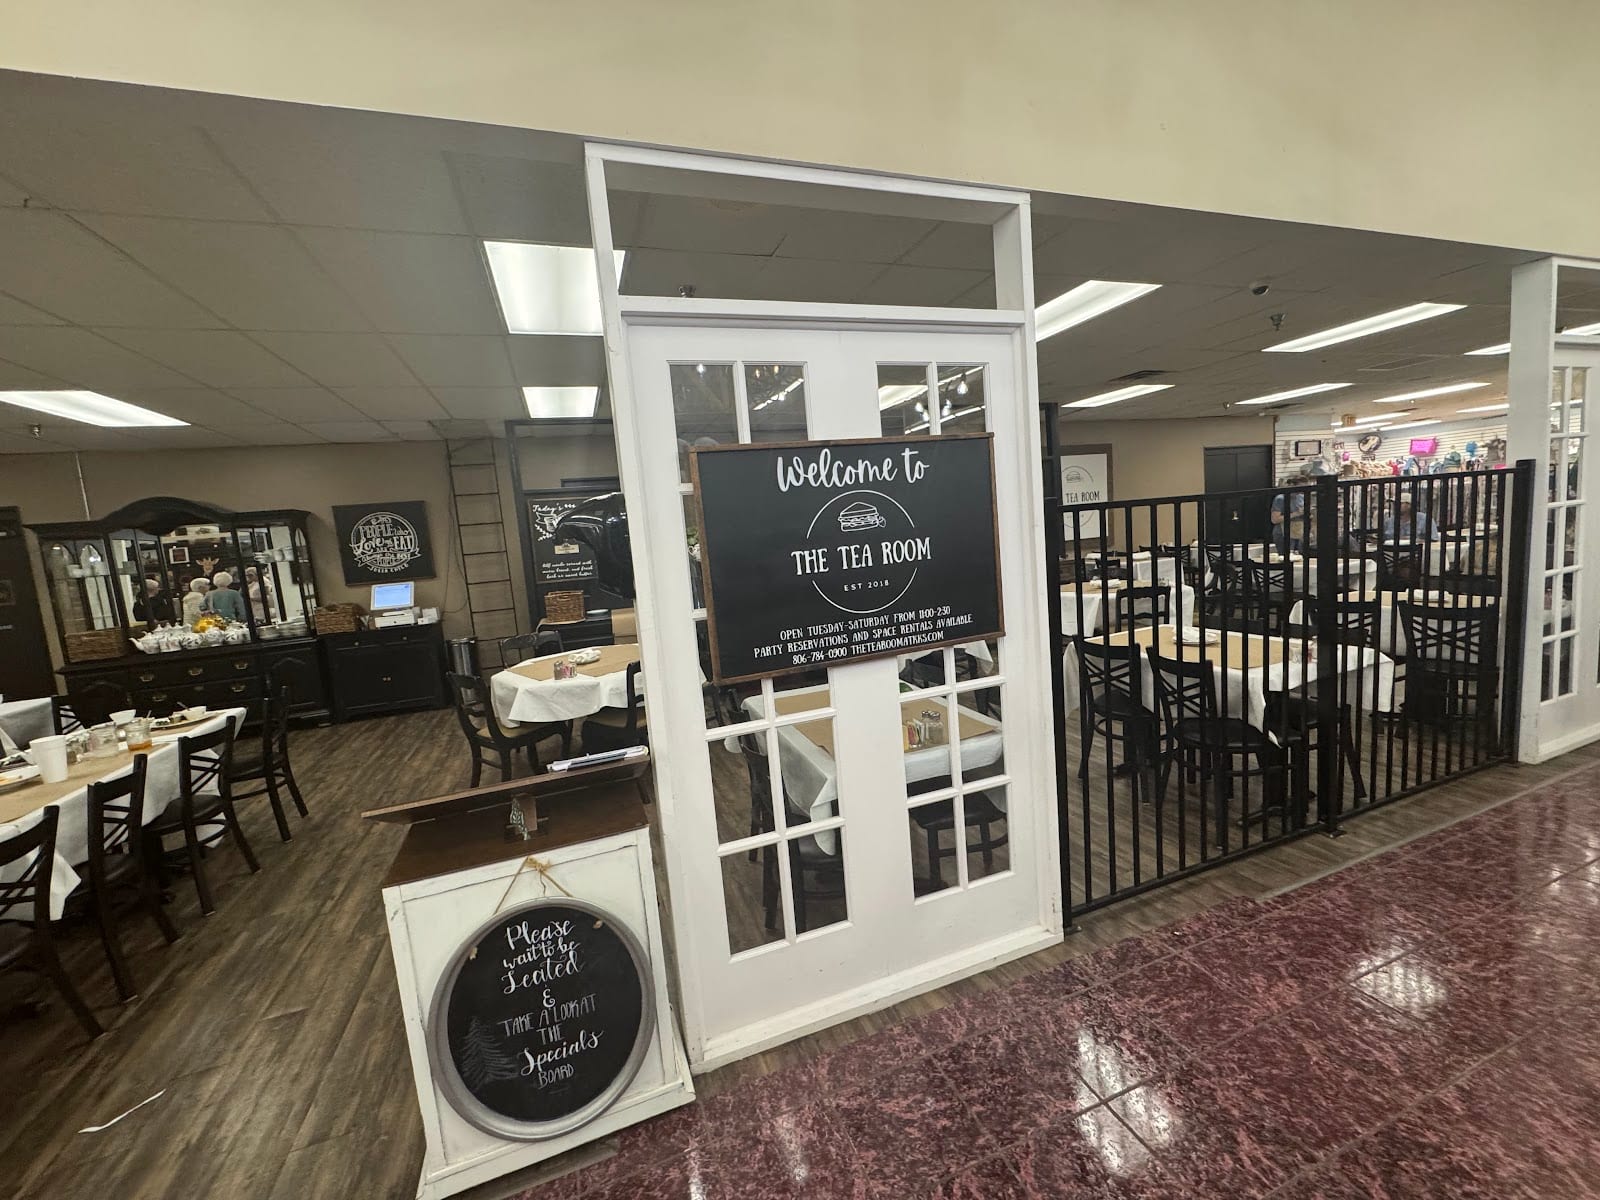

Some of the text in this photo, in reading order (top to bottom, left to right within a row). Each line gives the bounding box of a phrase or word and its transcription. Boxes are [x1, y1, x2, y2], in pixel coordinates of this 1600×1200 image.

[777, 447, 930, 492] Welcome to
[1065, 490, 1100, 503] TEA ROOM
[791, 537, 932, 575] THE TEA ROOM
[844, 580, 889, 592] EST 2018
[753, 613, 973, 658] PARTY RESERVATIONS AND SPACE RENTALS AVAILABLE
[780, 628, 803, 640] OPEN
[807, 614, 890, 636] TUESDAY-SATURDAY
[894, 611, 916, 623] FROM
[792, 647, 848, 665] 806-784-0900
[504, 920, 576, 950] Please
[503, 937, 580, 969] wait to be
[501, 950, 582, 995] Seated
[543, 988, 556, 1008] &
[497, 993, 597, 1037] TAKE A LOOK AT
[536, 1023, 565, 1045] THE
[516, 1029, 605, 1076] Specials
[538, 1063, 575, 1089] BOARD
